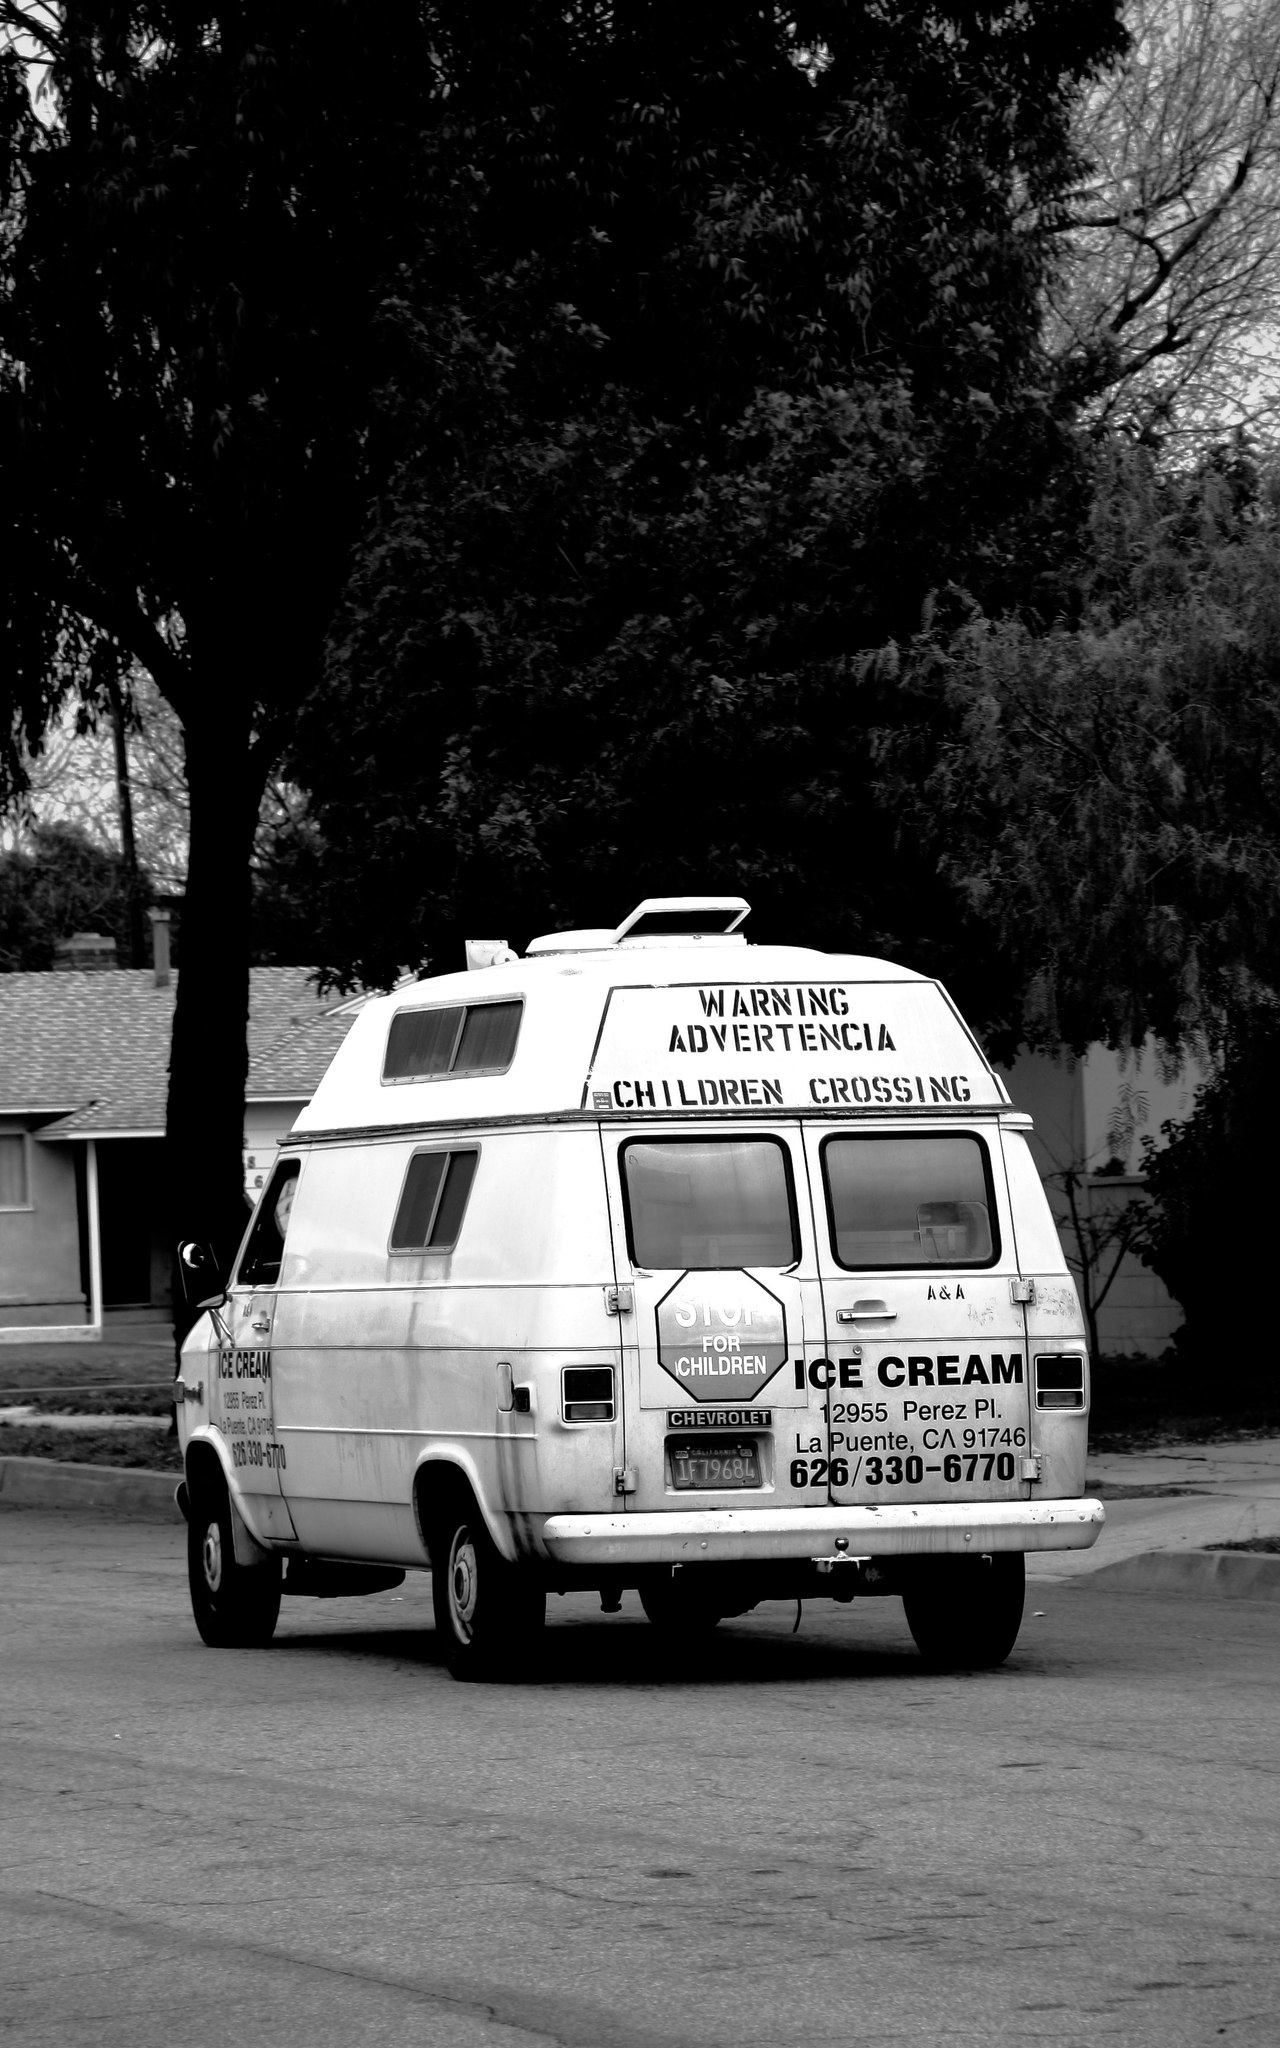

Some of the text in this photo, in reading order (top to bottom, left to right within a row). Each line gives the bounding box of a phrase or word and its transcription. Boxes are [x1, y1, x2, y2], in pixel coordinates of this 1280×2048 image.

[699, 988, 848, 1017] WARNING
[668, 1023, 896, 1053] ADVERTENCIA
[614, 1078, 784, 1108] CHILDREN
[809, 1075, 972, 1104] CROSSING
[702, 1335, 741, 1353] FOR
[218, 1351, 271, 1379] ICE CREAM
[677, 1355, 767, 1377] CHILDREN
[794, 1353, 1024, 1389] ICE CREAM
[671, 1411, 769, 1425] CHEVROLET
[820, 1398, 1002, 1424] 12955 Perez Pl.
[796, 1433, 823, 1453] La
[830, 1431, 915, 1453] Puente,
[962, 1427, 1026, 1448] 91746
[679, 1458, 756, 1481] 1F79684
[790, 1452, 1015, 1488] 626/330-6770
